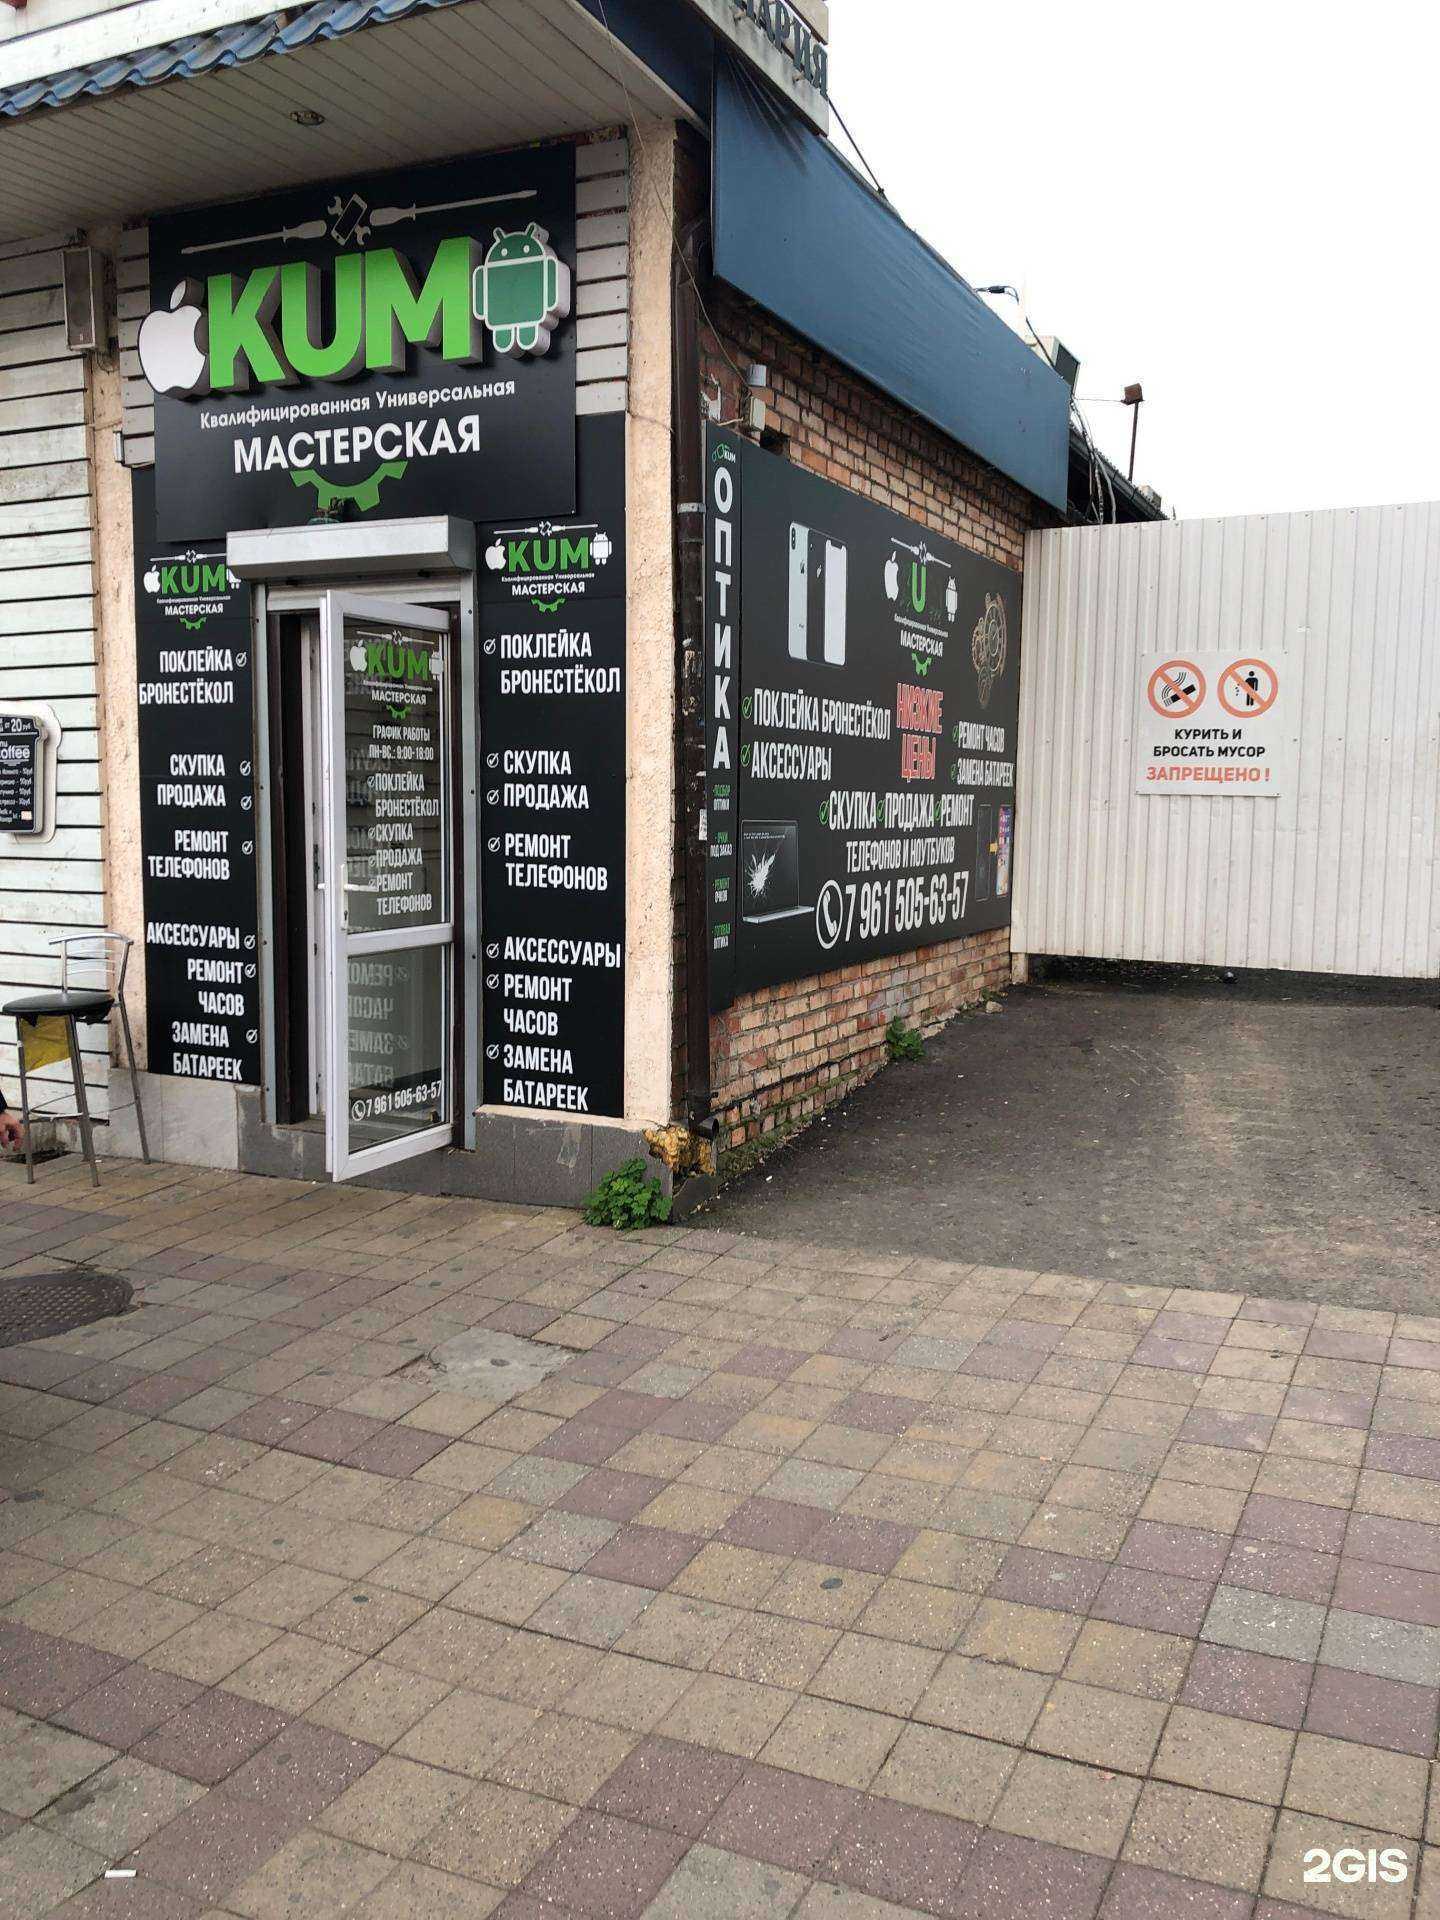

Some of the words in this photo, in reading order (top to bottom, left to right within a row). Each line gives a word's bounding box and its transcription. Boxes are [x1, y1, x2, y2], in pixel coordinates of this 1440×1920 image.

[207, 236, 478, 389] KUM
[200, 397, 370, 430] Квалифицированная
[376, 379, 516, 411] Универсальная
[234, 414, 481, 474] МАСТЕРСКАЯ
[508, 537, 589, 573] KUM
[161, 564, 226, 595] KUM
[512, 581, 586, 596] МАСТЕРСКАЯ
[165, 603, 224, 616] МАСТЕРСКАЯ
[713, 466, 733, 770] ОПТИКА
[500, 629, 592, 660] ПОКЛЕЙКА
[900, 629, 944, 657] МАСТЕРСКАЯ
[160, 646, 234, 673] ПОКЛЕЙКА
[368, 641, 429, 681] KUM
[139, 679, 234, 705] БРОНЕСТЁКОЛ
[500, 665, 622, 694] БРОНЕСТЁКОЛ
[371, 689, 427, 705] МАСТЕРСКАЯ
[896, 682, 944, 734] НИЗКИЕ
[11, 718, 22, 733] 20
[753, 688, 820, 732] ПОКЛЕЙКА
[822, 698, 891, 740] БРОНЕСТЁКОЛ
[372, 725, 401, 740] ГРАФИК
[402, 726, 431, 742] РАБОТЫ
[958, 720, 985, 750] РЕМОНТ
[985, 725, 1005, 753] ЧАСОВ
[1174, 729, 1229, 740] КУРИТЬ
[1232, 729, 1242, 740] И
[0, 745, 30, 759] offee
[169, 754, 226, 777] СКУПКА
[503, 750, 572, 775] СКУПКА
[751, 743, 832, 781] АКСЕССУАРЫ
[901, 733, 937, 783] ЦЕНЫ
[1153, 746, 1215, 757] БРОСАТЬ
[1217, 746, 1266, 757] МУСОР
[375, 771, 425, 791] ПОКЛЕЙКА
[957, 758, 984, 786] ЗАМЕНА
[157, 784, 226, 809] ПРОДАЖА
[376, 796, 439, 817] БРОНЕСТЁКОЛ
[503, 783, 590, 811] ПРОДАЖА
[829, 791, 876, 830] СКУПКА
[884, 792, 935, 832] ПРОДАЖА
[940, 794, 975, 826] РЕМОНТ
[174, 830, 229, 853] РЕМОНТ
[376, 822, 414, 841] СКУПКА
[504, 832, 571, 859] РЕМОНТ
[148, 855, 230, 881] ТЕЛЕФОНОВ
[376, 848, 423, 868] ПРОДАЖА
[846, 839, 901, 873] ТЕЛЕФОНОВ
[902, 841, 910, 864] И
[911, 836, 955, 868] НОУТБУКОВ
[376, 872, 414, 892] РЕМОНТ
[505, 863, 608, 891] ТЕЛЕФОНОВ
[376, 893, 433, 916] ТЕЛЕФОНОВ
[844, 882, 857, 942] 7
[859, 878, 891, 940] 961
[895, 870, 970, 932] 505-63-57
[146, 922, 240, 950] АКСЕССУАРЫ
[504, 936, 621, 968] АКСЕССУАРЫ
[187, 958, 244, 985] РЕМОНТ
[504, 973, 573, 1003] РЕМОНТ
[198, 991, 245, 1017] ЧАСОВ
[172, 1021, 230, 1048] ЗАМЕНА
[504, 1008, 559, 1036] ЧАСОВ
[173, 1052, 243, 1082] БАТАРЕЕК
[503, 1044, 574, 1075] ЗАМЕНА
[365, 1099, 373, 1117] 7
[374, 1092, 392, 1115] 961
[394, 1080, 442, 1109] 505-63-57
[503, 1079, 589, 1112] БАТАРЕЕК
